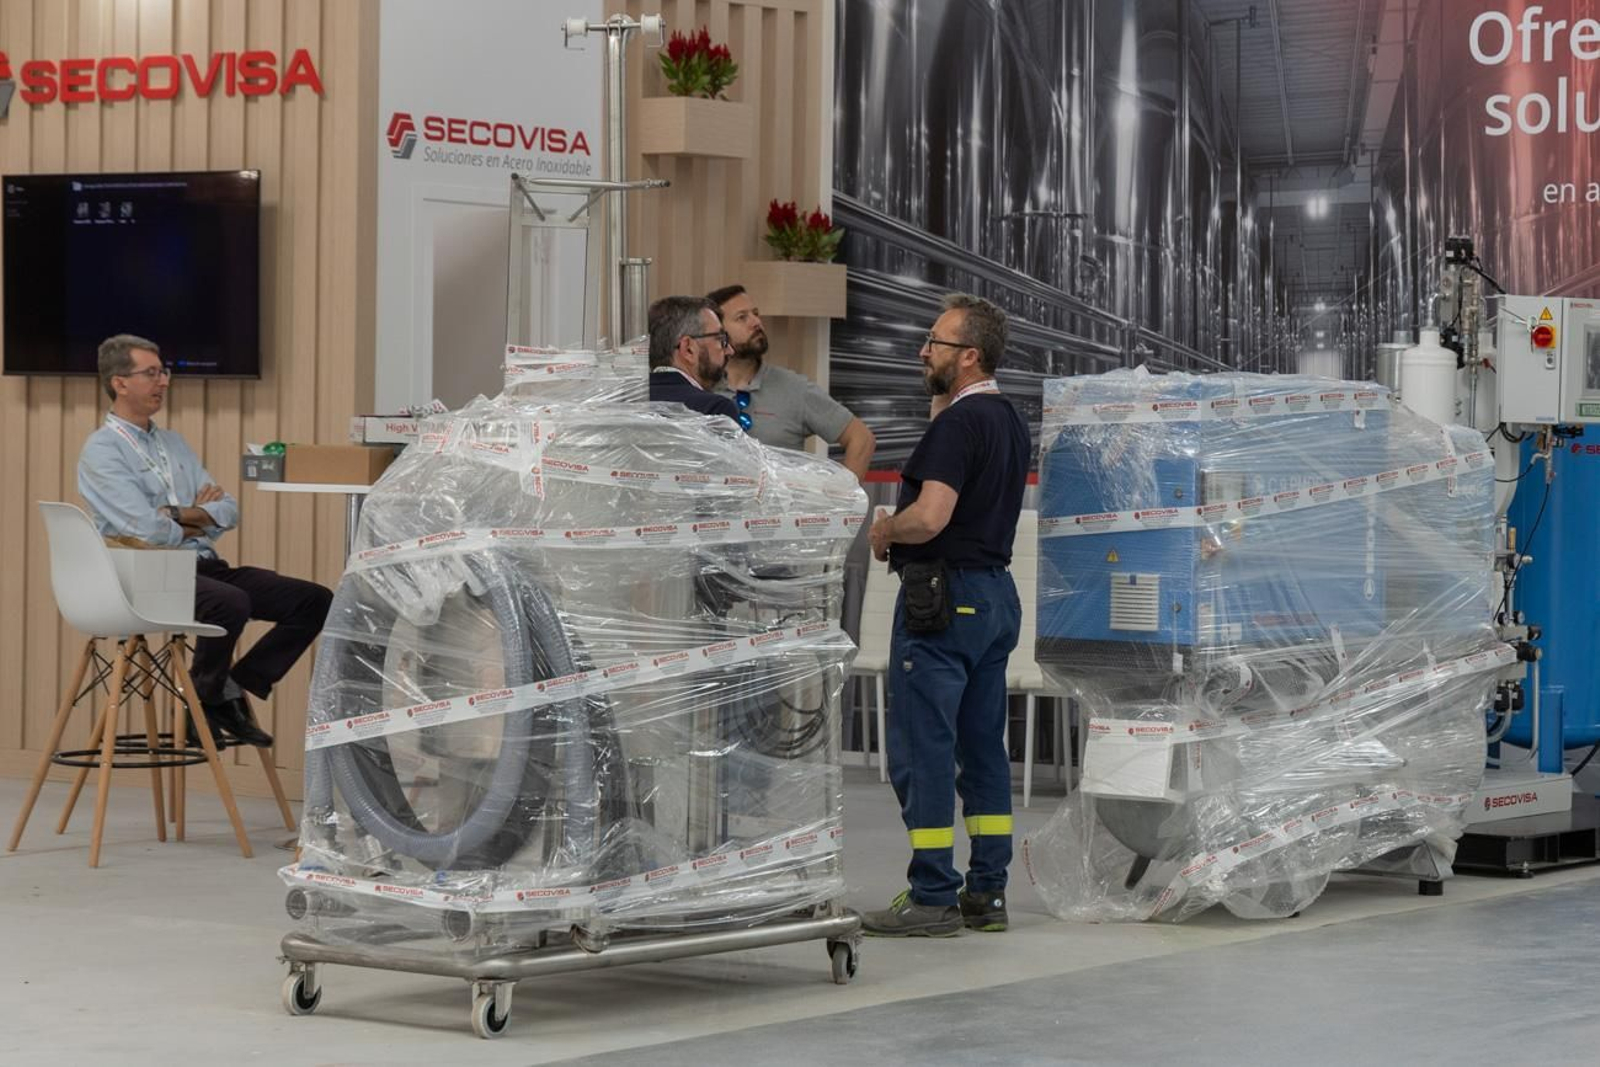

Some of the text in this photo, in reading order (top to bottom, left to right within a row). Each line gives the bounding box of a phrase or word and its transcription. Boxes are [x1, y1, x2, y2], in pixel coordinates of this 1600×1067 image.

[1469, 6, 1600, 65] Ofre
[20, 49, 323, 103] SECOVISA
[1485, 76, 1600, 136] solu
[423, 116, 591, 156] SECOVISA
[424, 146, 592, 176] Soluciones en Acero Inoxidable
[1543, 182, 1575, 203] en
[386, 423, 409, 434] High
[1082, 513, 1118, 521] SECOVISA
[1141, 508, 1178, 517] SECOVISA
[658, 651, 690, 664] SECOVISA
[475, 689, 513, 702] SECOVISA
[413, 701, 451, 714] SECOVISA
[353, 712, 390, 725] SECOVISA
[1492, 792, 1538, 808] SECOVISA
[383, 885, 424, 896] SECOVISA
[525, 888, 571, 898] SECOVISA
